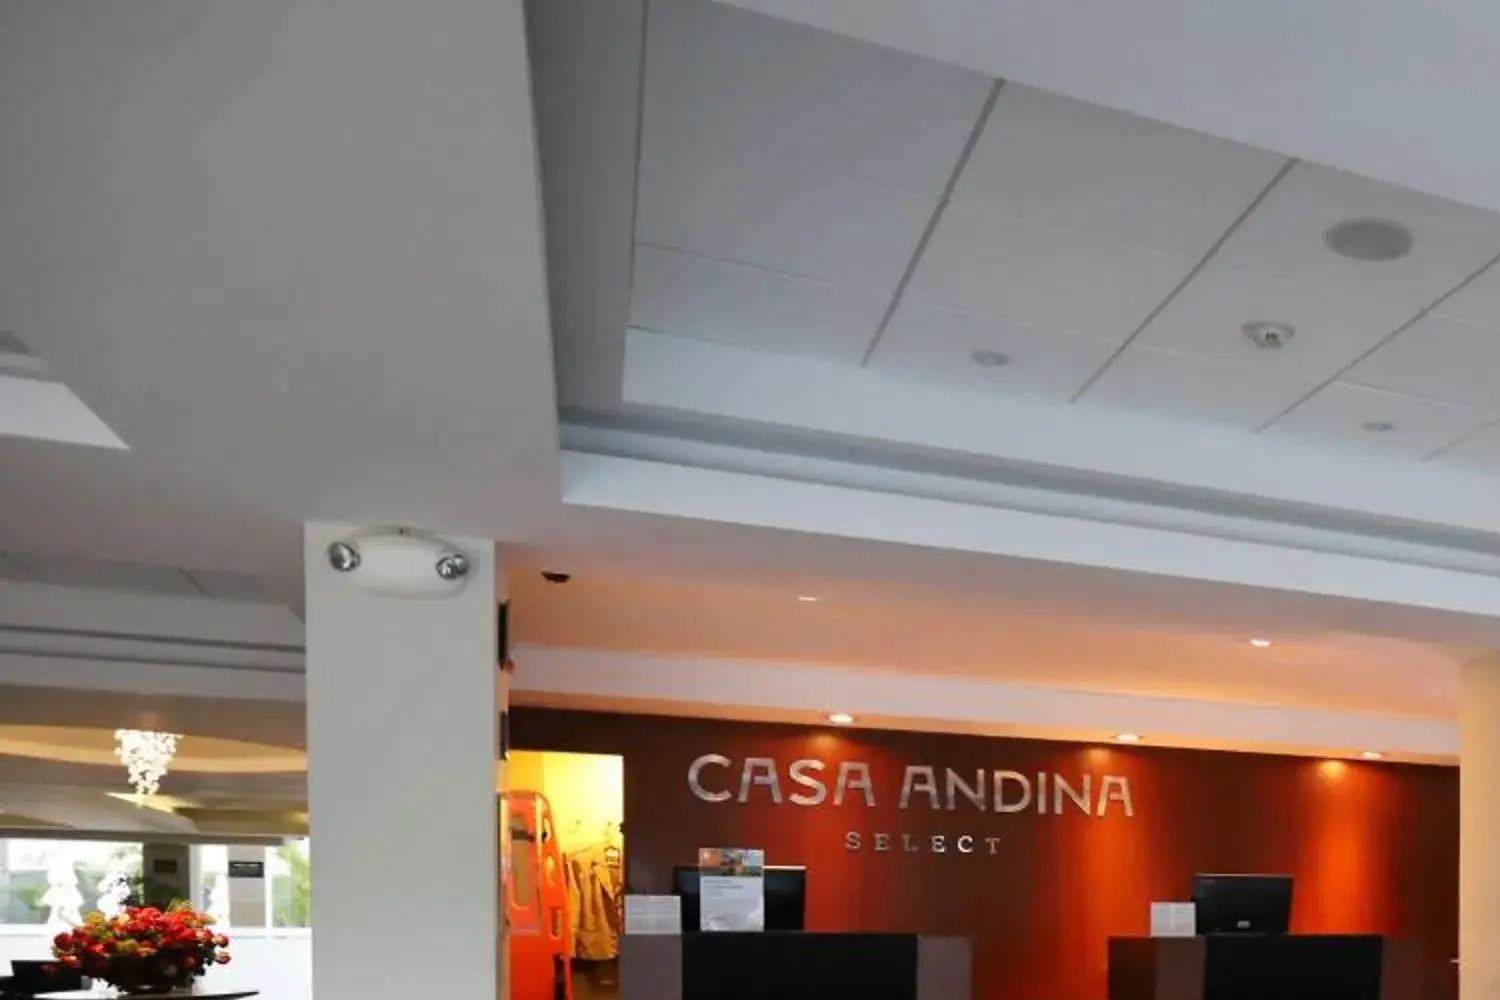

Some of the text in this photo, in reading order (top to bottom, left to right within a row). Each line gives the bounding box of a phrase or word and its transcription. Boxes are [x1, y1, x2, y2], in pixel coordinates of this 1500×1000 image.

[687, 753, 1134, 817] CASA ANDINA
[845, 831, 1001, 855] SELECT
